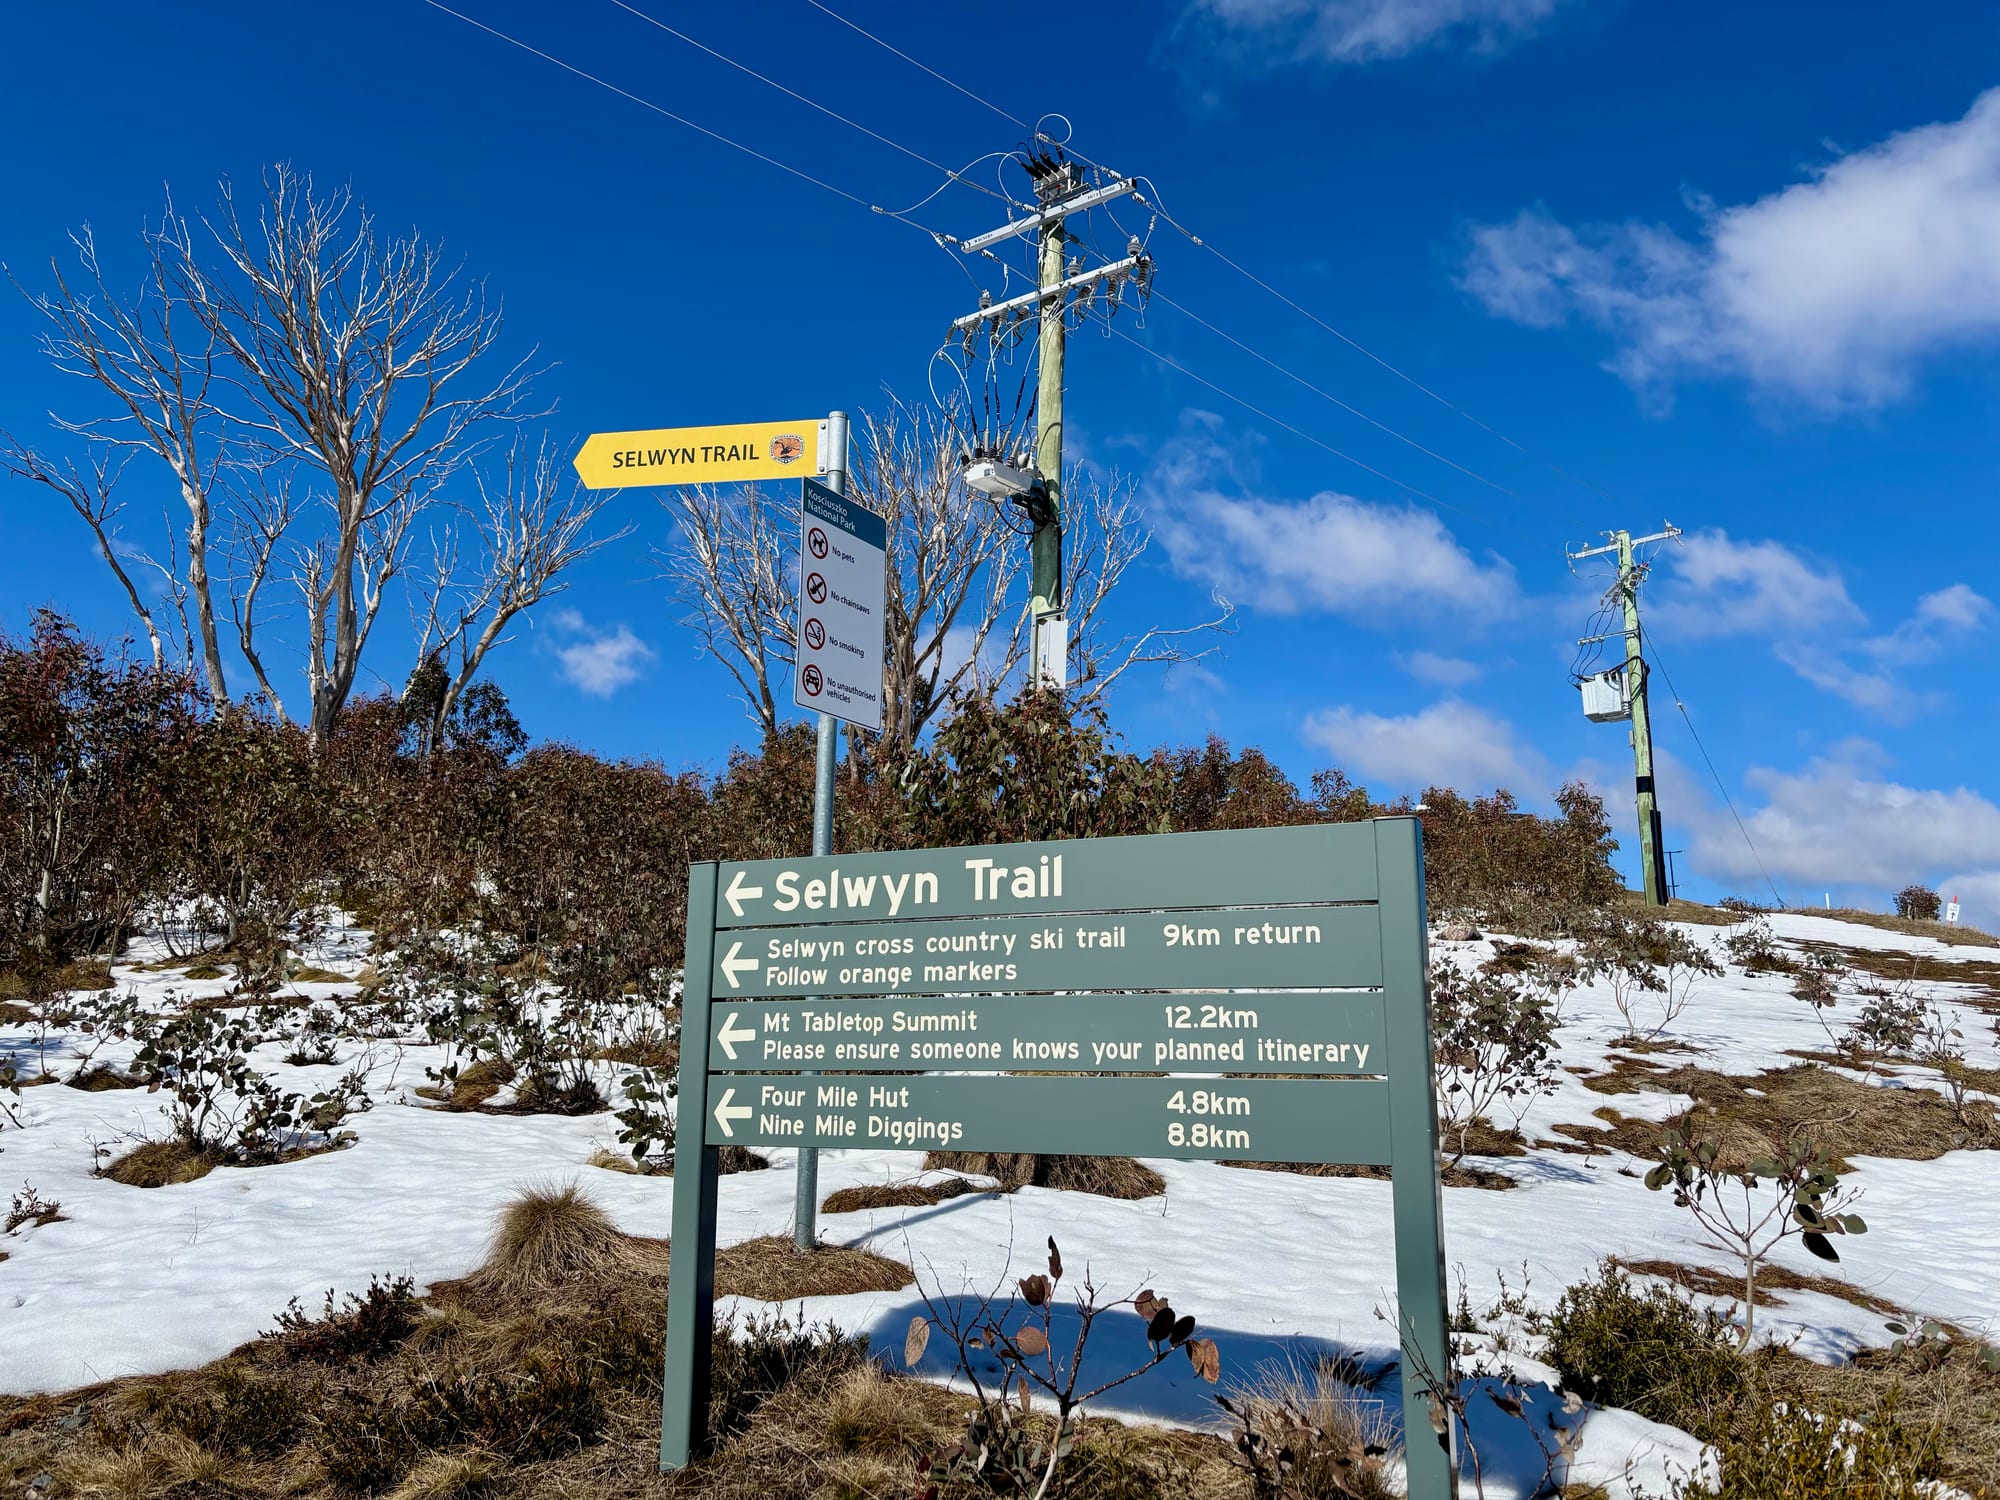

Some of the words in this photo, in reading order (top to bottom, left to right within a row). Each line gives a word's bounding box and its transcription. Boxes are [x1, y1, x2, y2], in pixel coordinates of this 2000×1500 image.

[612, 447, 696, 469] SELWYN
[700, 444, 760, 463] TRAIL
[808, 488, 848, 517] Kosciuszko
[808, 500, 839, 524] National
[840, 516, 856, 532] Park
[832, 546, 841, 557] No
[842, 552, 855, 564] pets
[831, 590, 840, 601] No
[840, 596, 870, 615] chainsaws
[829, 635, 838, 646] No
[839, 641, 865, 659] smoking
[826, 689, 851, 704] vehicles
[827, 676, 836, 688] No
[837, 682, 876, 702] unauthorised
[773, 869, 939, 917] Selwyn
[965, 854, 1063, 901] Trail
[767, 938, 845, 963] Selwyn
[855, 936, 915, 956] cross
[925, 930, 1017, 956] country
[1030, 928, 1063, 950] ski
[1075, 925, 1126, 949] trail
[1163, 923, 1221, 947] 9km
[1234, 921, 1321, 945] return
[766, 965, 828, 987] Follow
[839, 964, 913, 990] orange
[923, 959, 1018, 982] markers
[763, 1011, 791, 1033] Mt
[801, 1011, 884, 1037] Tabletop
[891, 1009, 978, 1033] Summit
[1165, 1004, 1258, 1029] 12.2km
[763, 1039, 825, 1060] Please
[835, 1042, 900, 1060] ensure
[910, 1042, 1002, 1060] someone
[1012, 1037, 1080, 1060] knows
[1091, 1041, 1143, 1066] your
[1155, 1037, 1245, 1066] planned
[1257, 1036, 1370, 1069] itinerary
[761, 1085, 806, 1107] Four
[817, 1085, 858, 1108] Mile
[869, 1086, 909, 1108] Hut
[1166, 1090, 1251, 1116] 4.8km
[759, 1113, 805, 1136] Nine
[815, 1114, 857, 1137] Mile
[868, 1115, 963, 1147] Diggings
[1167, 1122, 1250, 1149] 8.8km
